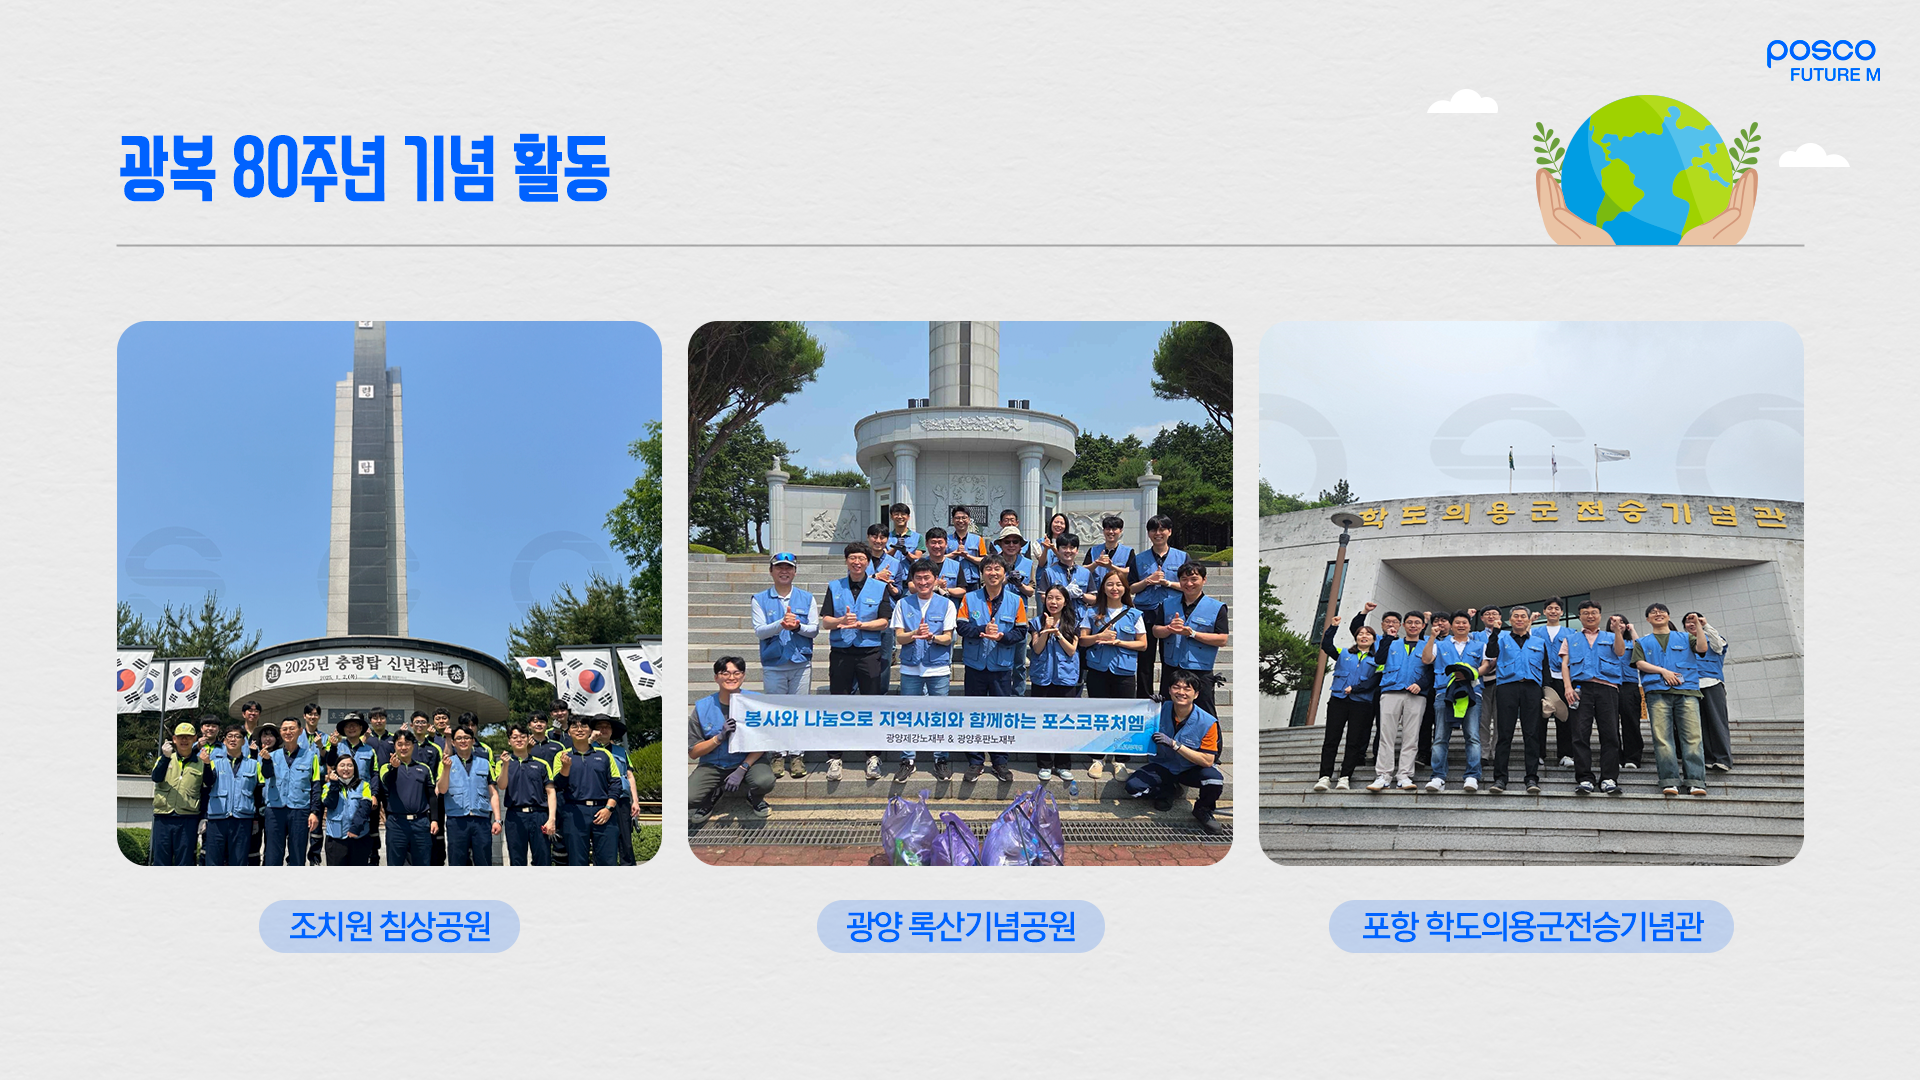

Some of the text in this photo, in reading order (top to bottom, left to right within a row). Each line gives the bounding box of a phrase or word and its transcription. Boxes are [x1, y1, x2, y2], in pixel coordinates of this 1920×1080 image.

[1359, 499, 1788, 529] 학도의용군전승기념관
[285, 655, 444, 676] 2025년 충령탑 신년참배
[744, 710, 1145, 732] 봉사와 나눔으로 지역사회와 함께하는 포스코퓨처엠
[886, 733, 1016, 745] 광양제강노재부 & 광양후판노재부
